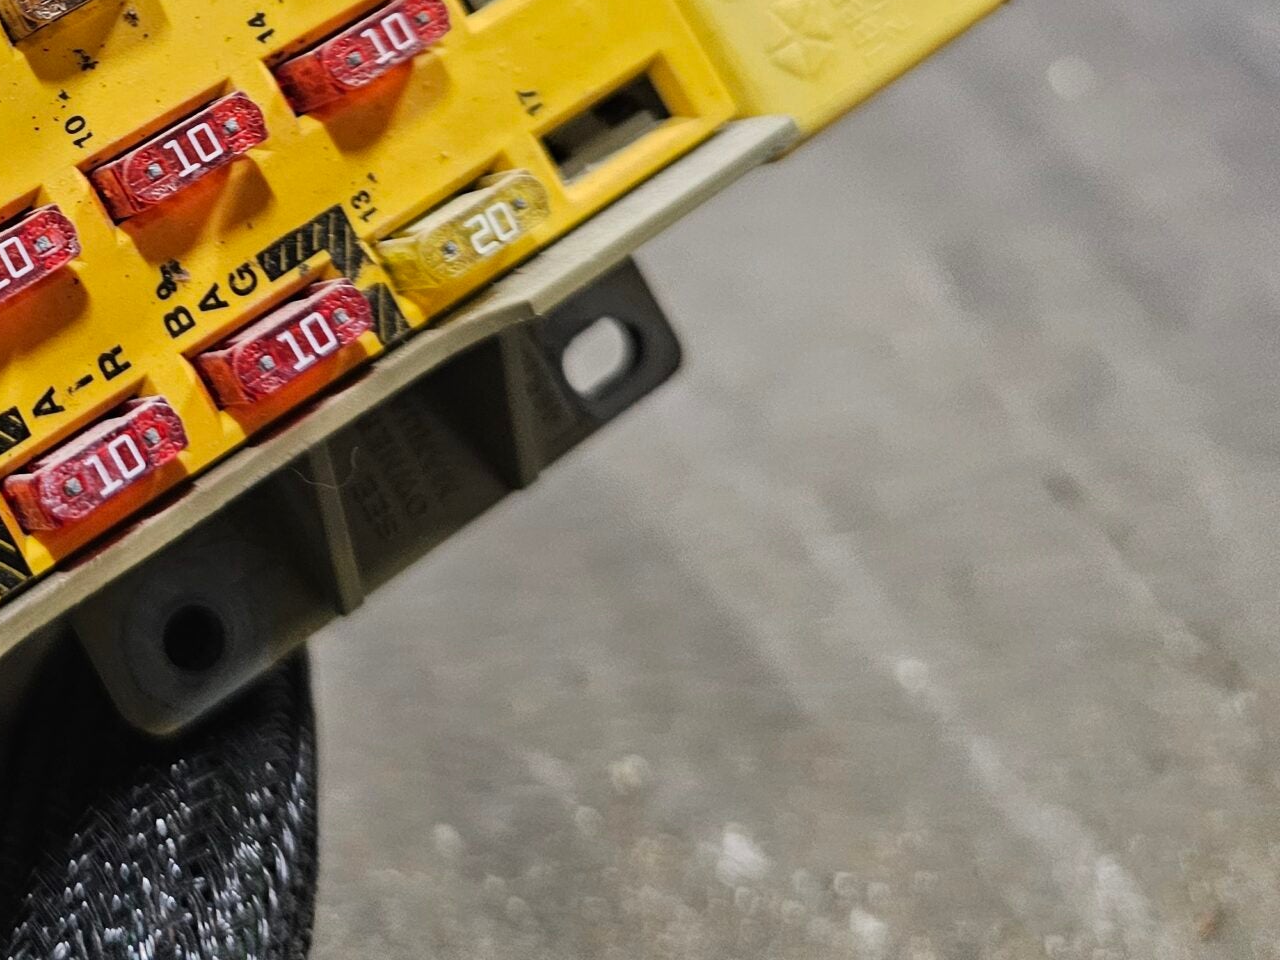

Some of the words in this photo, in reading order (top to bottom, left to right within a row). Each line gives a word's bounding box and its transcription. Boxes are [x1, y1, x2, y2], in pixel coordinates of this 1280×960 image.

[247, 11, 276, 44] 14
[361, 12, 418, 65] 10
[516, 90, 545, 116] 17
[65, 113, 93, 150] 10
[163, 122, 224, 178] 10
[350, 190, 379, 223] 13
[463, 201, 519, 257] 20
[276, 311, 341, 372] 10
[83, 436, 147, 498] 10
